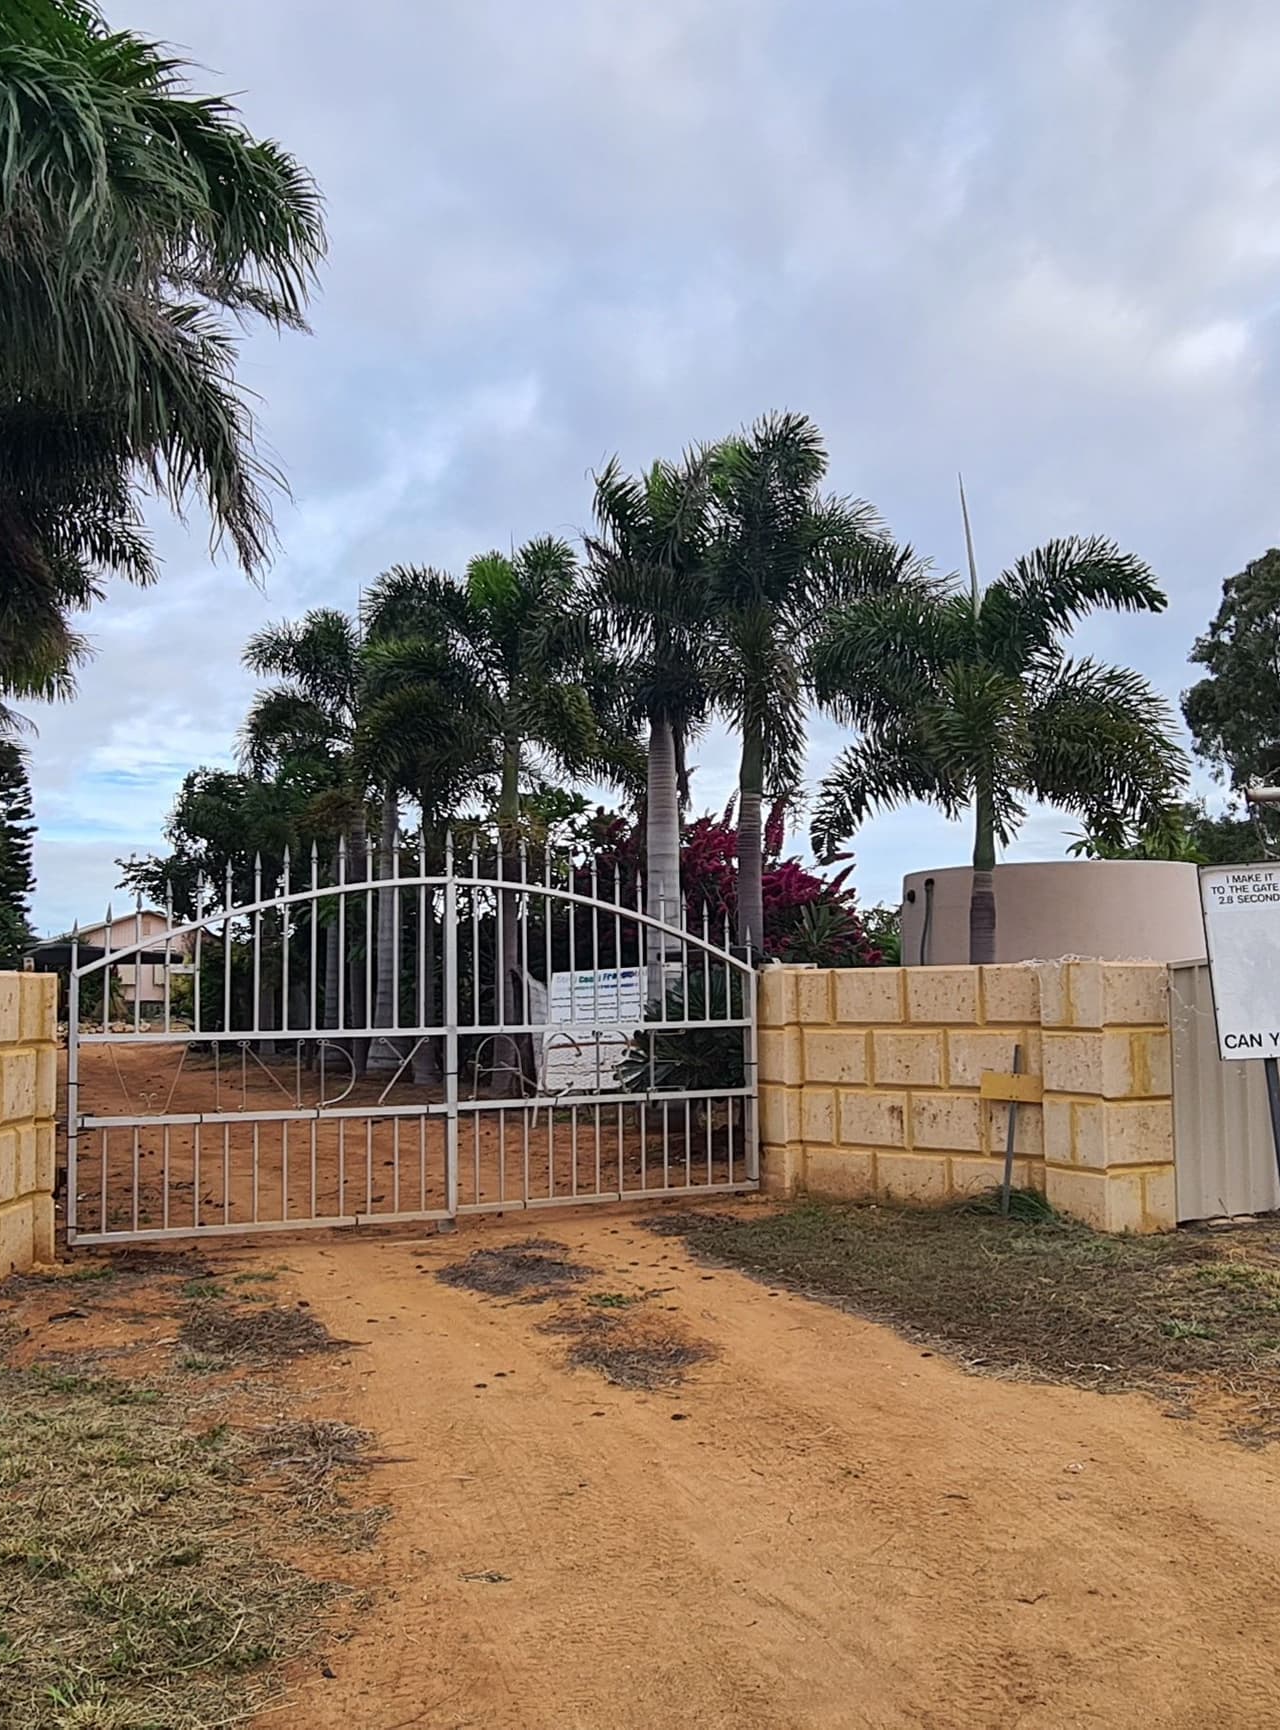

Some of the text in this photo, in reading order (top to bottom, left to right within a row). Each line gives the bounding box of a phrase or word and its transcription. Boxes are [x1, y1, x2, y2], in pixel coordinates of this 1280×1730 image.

[1232, 873, 1262, 884] MAKE
[1265, 872, 1274, 882] IT
[1211, 886, 1225, 895] TO
[1228, 884, 1249, 894] THE
[1252, 883, 1279, 893] GATE
[1224, 1033, 1263, 1049] CAN
